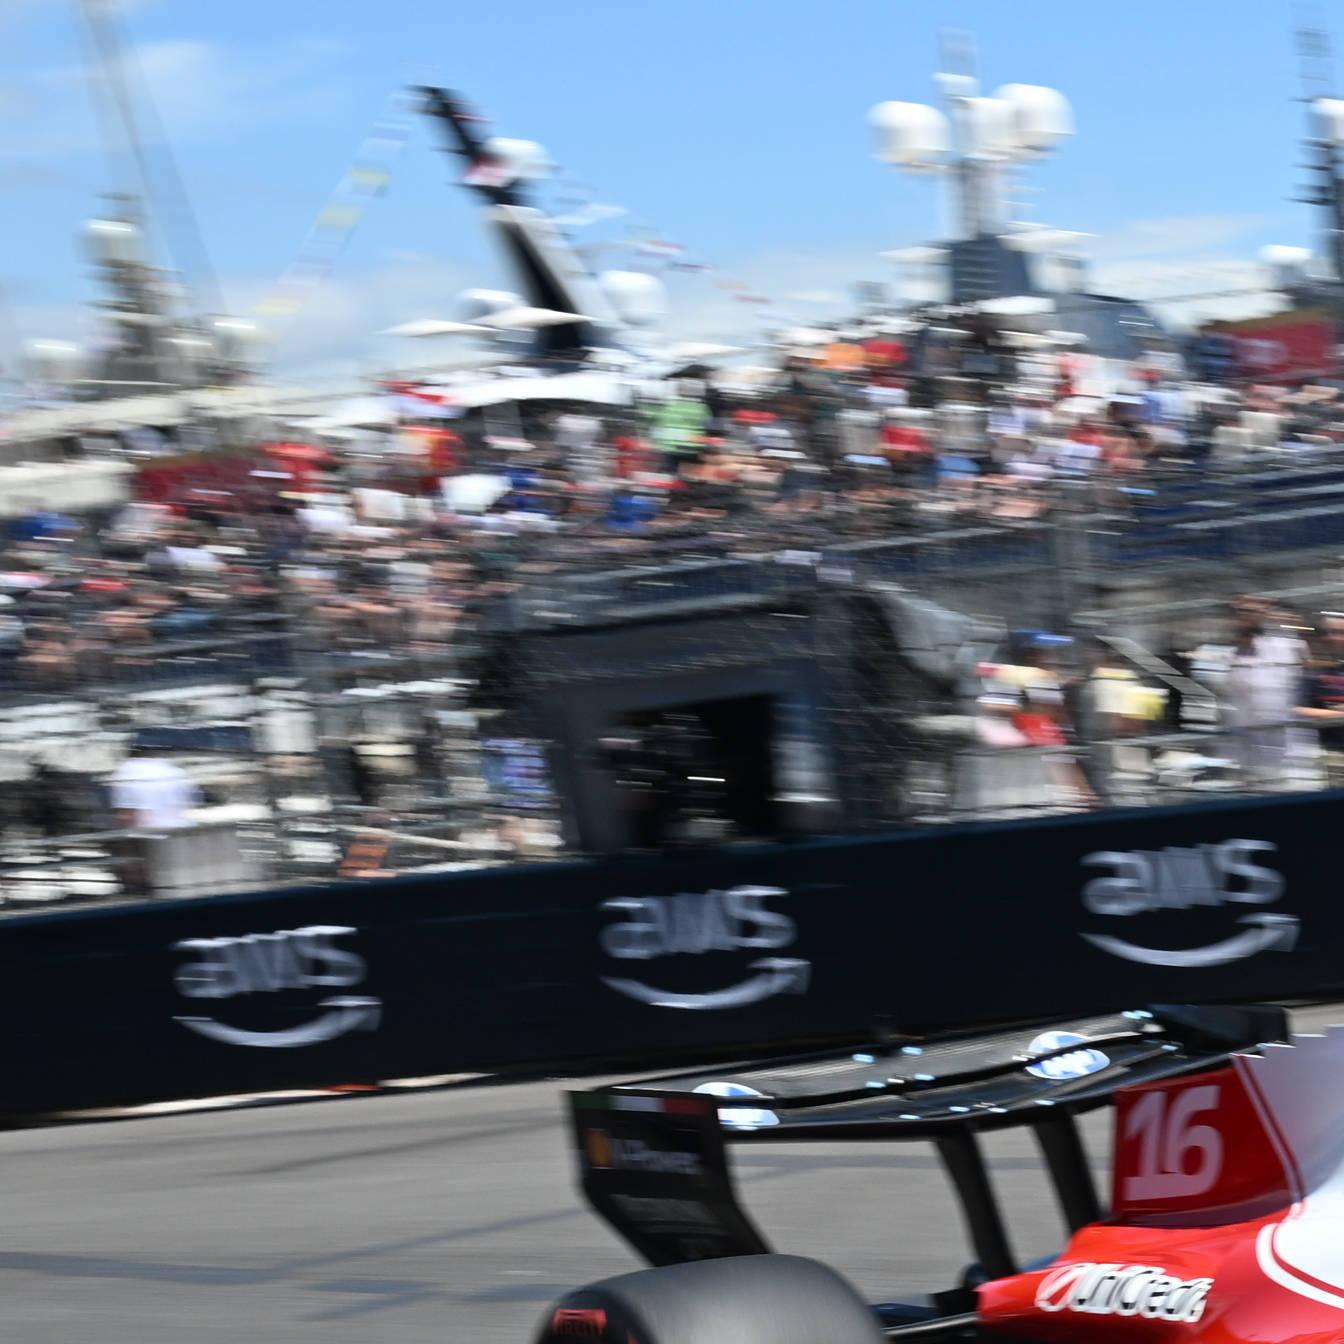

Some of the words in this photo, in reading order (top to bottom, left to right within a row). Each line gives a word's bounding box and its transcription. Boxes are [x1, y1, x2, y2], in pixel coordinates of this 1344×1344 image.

[1082, 839, 1287, 916] aws
[601, 886, 797, 959] aws
[171, 925, 366, 998] aws
[1123, 1085, 1224, 1200] 16
[1066, 1263, 1215, 1323] UniCredit
